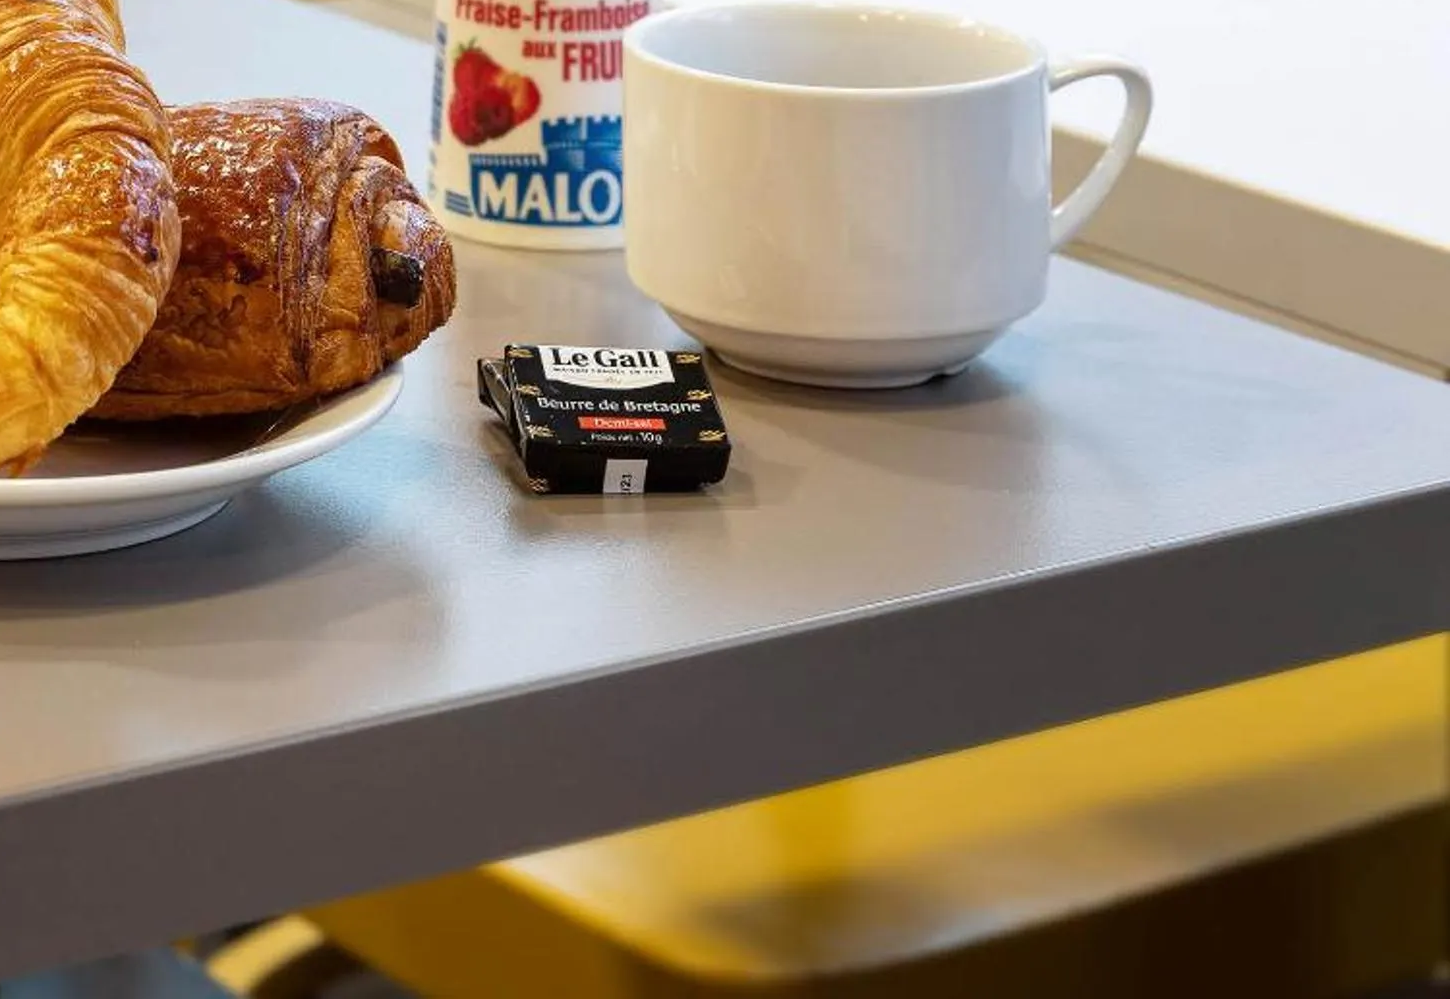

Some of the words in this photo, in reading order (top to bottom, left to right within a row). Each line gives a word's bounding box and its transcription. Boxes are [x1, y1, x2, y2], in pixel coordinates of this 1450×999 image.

[522, 39, 556, 58] aux
[478, 169, 622, 224] MALO
[551, 348, 589, 367] Le
[593, 349, 659, 368] Gall
[537, 397, 594, 411] Beurre
[598, 399, 620, 412] de
[623, 400, 702, 414] Bretagne
